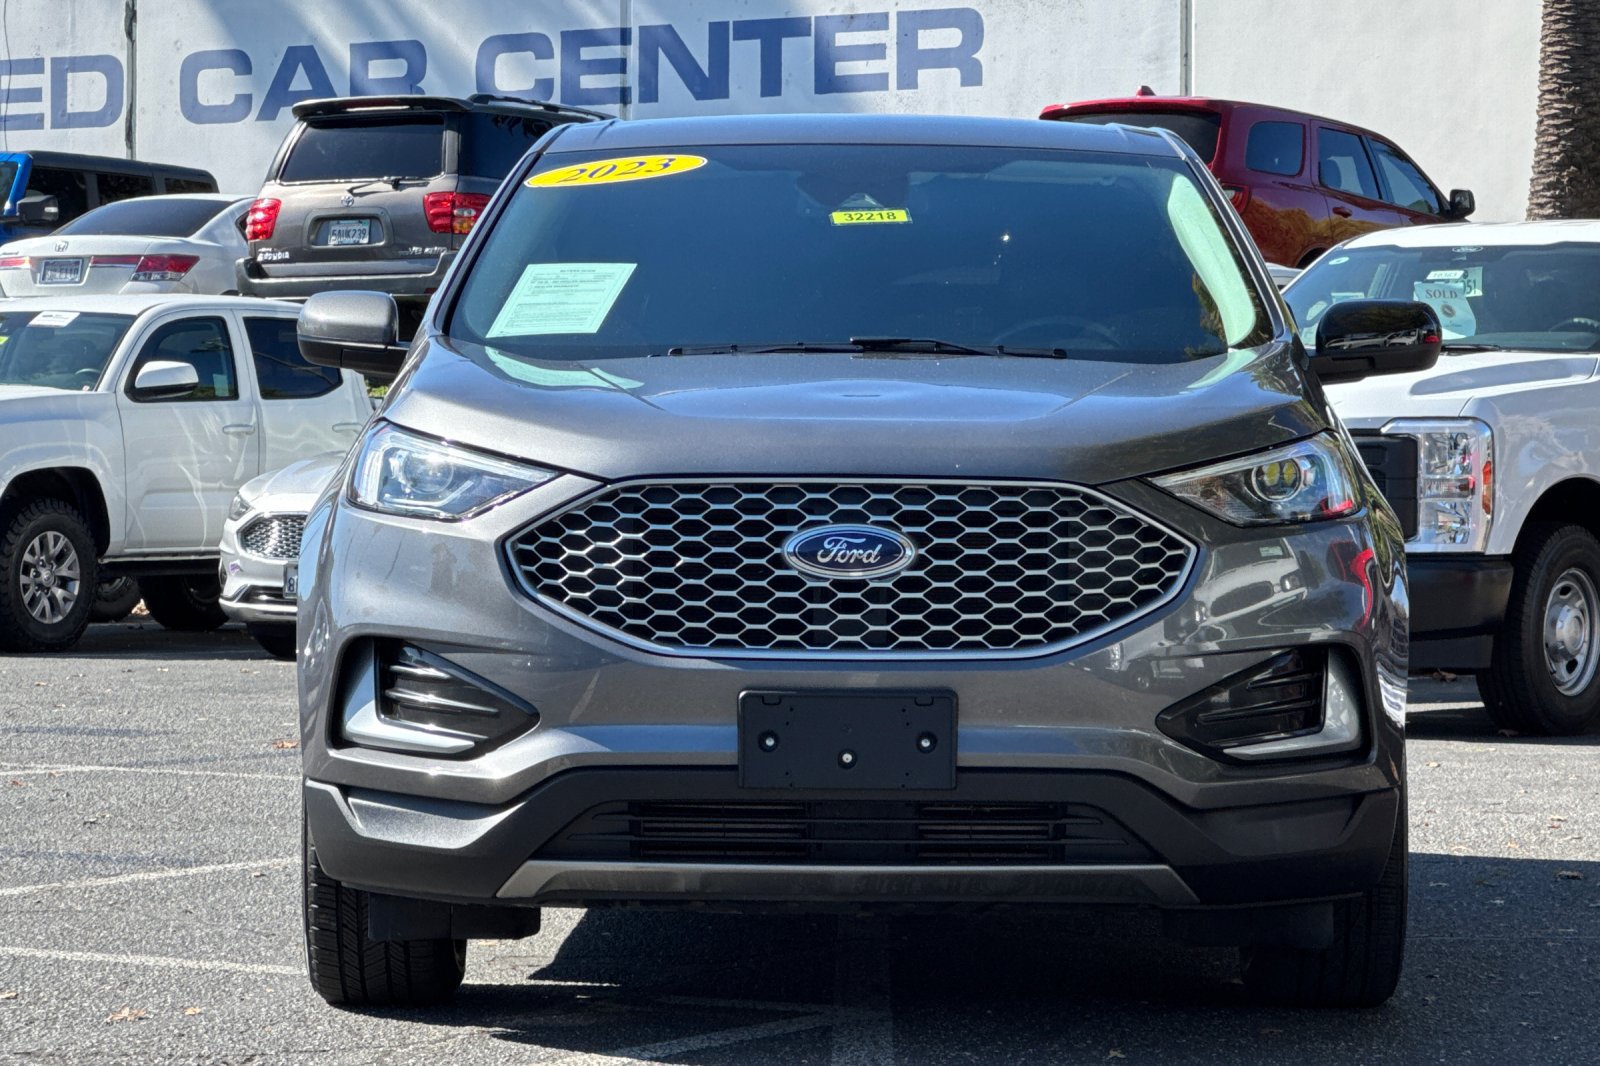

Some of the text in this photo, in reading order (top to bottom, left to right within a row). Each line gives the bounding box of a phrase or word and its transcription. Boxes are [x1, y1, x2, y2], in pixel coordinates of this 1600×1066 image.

[0, 7, 985, 132] ED CAR CENTER
[555, 157, 676, 185] 2023
[843, 212, 897, 222] 32218
[1425, 289, 1458, 299] SOLD
[817, 536, 883, 563] Ford
[288, 576, 298, 592] 8
